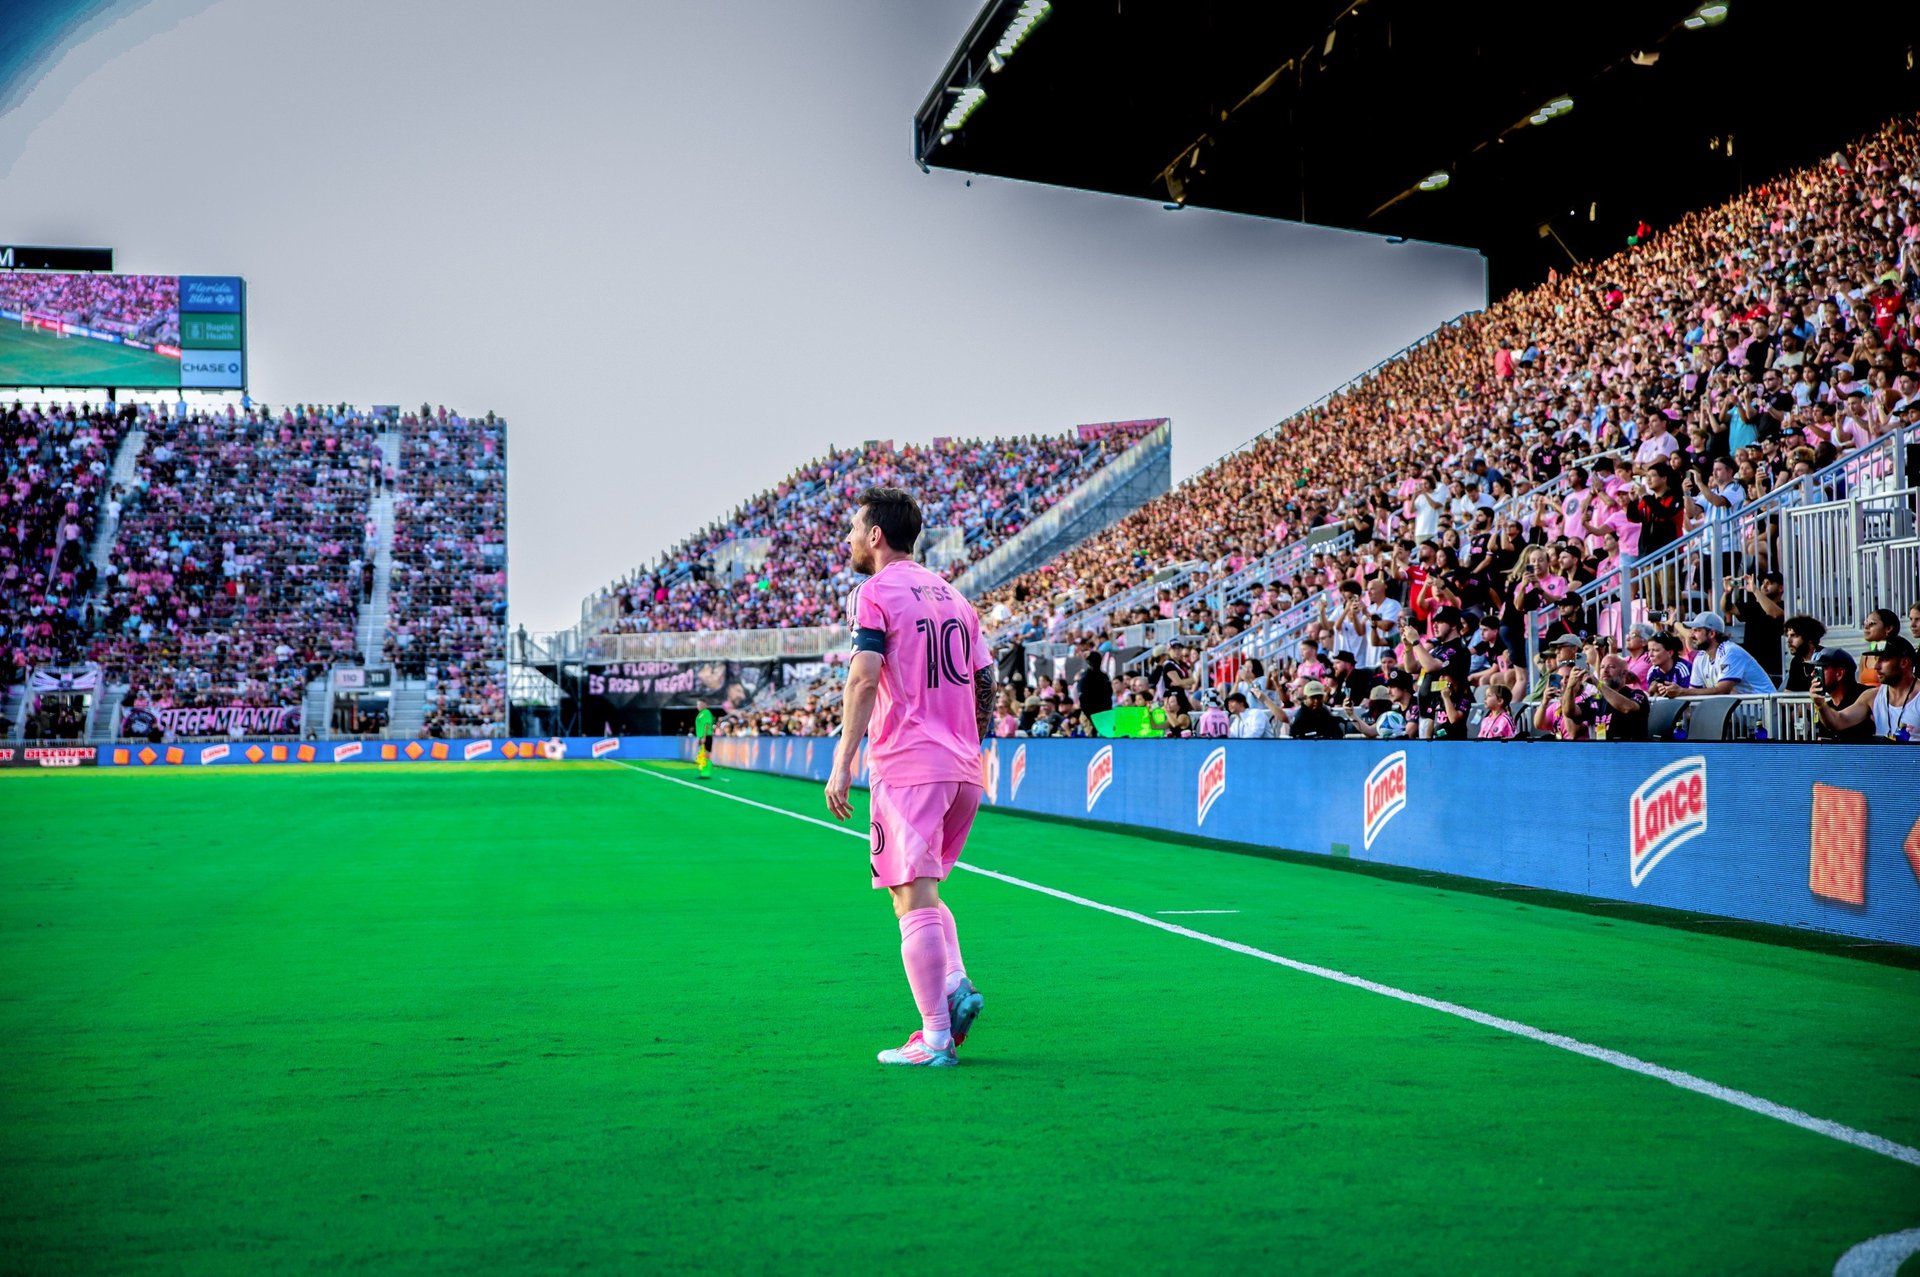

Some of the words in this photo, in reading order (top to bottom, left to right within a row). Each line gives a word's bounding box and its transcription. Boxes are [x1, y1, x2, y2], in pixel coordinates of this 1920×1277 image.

[188, 283, 232, 293] Florida
[188, 293, 213, 304] Blue
[206, 322, 235, 333] Baptist
[206, 331, 234, 340] Health
[182, 363, 226, 373] CHASE
[916, 616, 971, 689] 10
[623, 661, 679, 676] FLORIDA
[589, 674, 605, 694] ES
[608, 677, 640, 693] ROSA
[643, 679, 651, 693] Y
[654, 669, 694, 693] NEGRO
[25, 748, 96, 760] DISCOUNT
[1200, 758, 1223, 807] Lance
[1366, 765, 1405, 827] Lance
[1634, 774, 1703, 857] Lance
